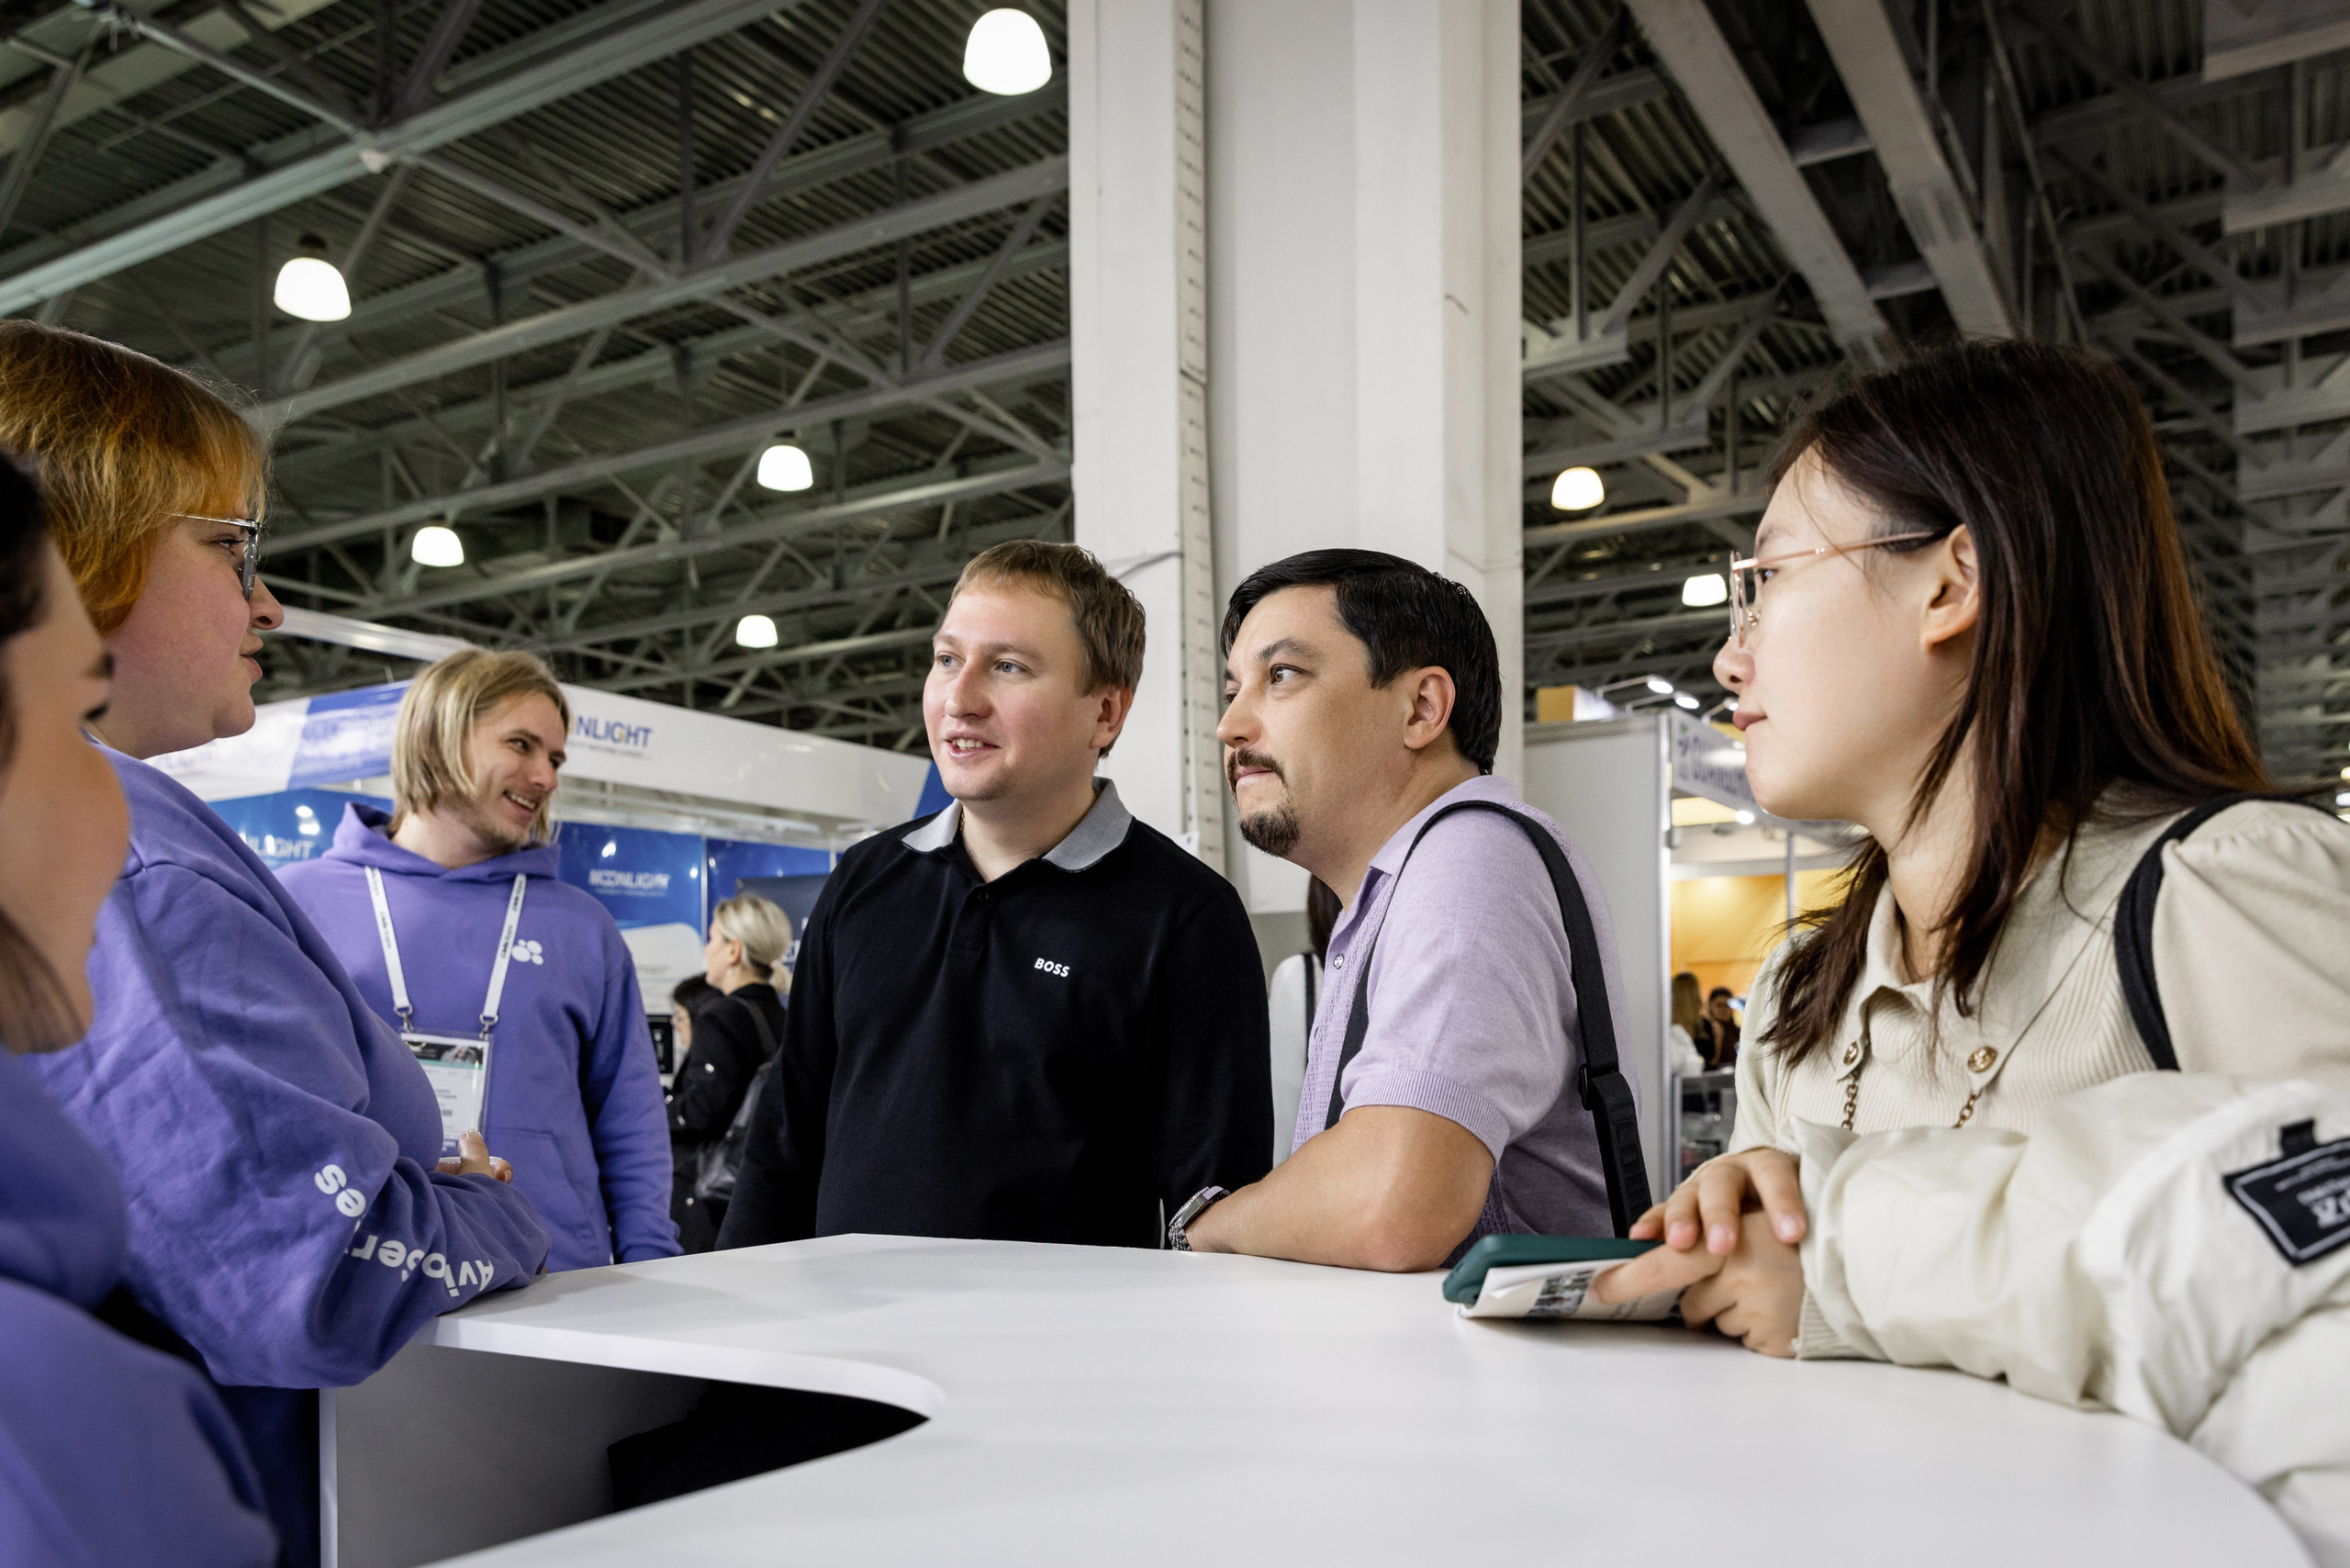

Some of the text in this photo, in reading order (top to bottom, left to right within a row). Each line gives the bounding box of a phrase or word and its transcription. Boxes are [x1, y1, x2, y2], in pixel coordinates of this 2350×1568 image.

[569, 713, 653, 748] NLIGHT
[1034, 958, 1070, 978] BOSS
[314, 1164, 495, 1297] AvioSeres
